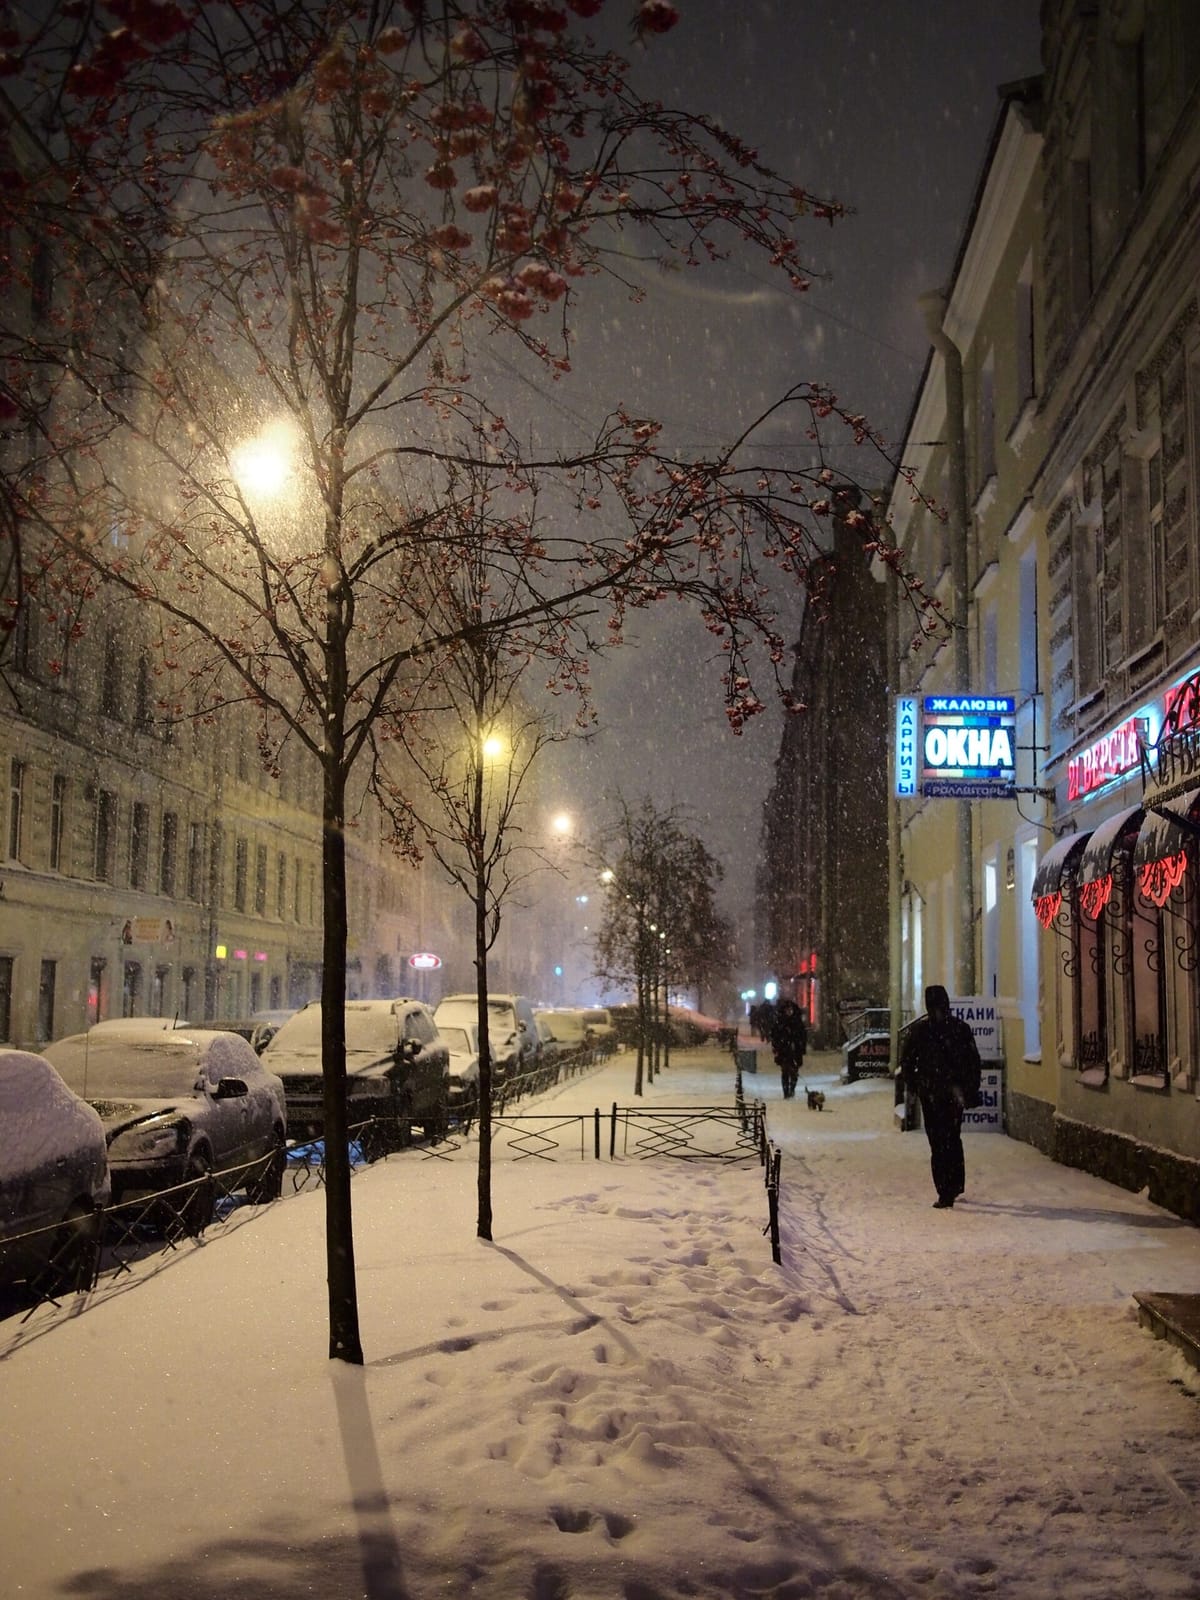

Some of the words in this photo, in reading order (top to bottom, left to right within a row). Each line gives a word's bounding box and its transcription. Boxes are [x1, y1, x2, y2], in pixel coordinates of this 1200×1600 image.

[932, 699, 1008, 711] ЖАЛЮЗИ
[898, 701, 914, 794] КАРНИЗЫ
[925, 728, 1013, 767] ОКНА
[1083, 718, 1139, 793] ВЕРСТА
